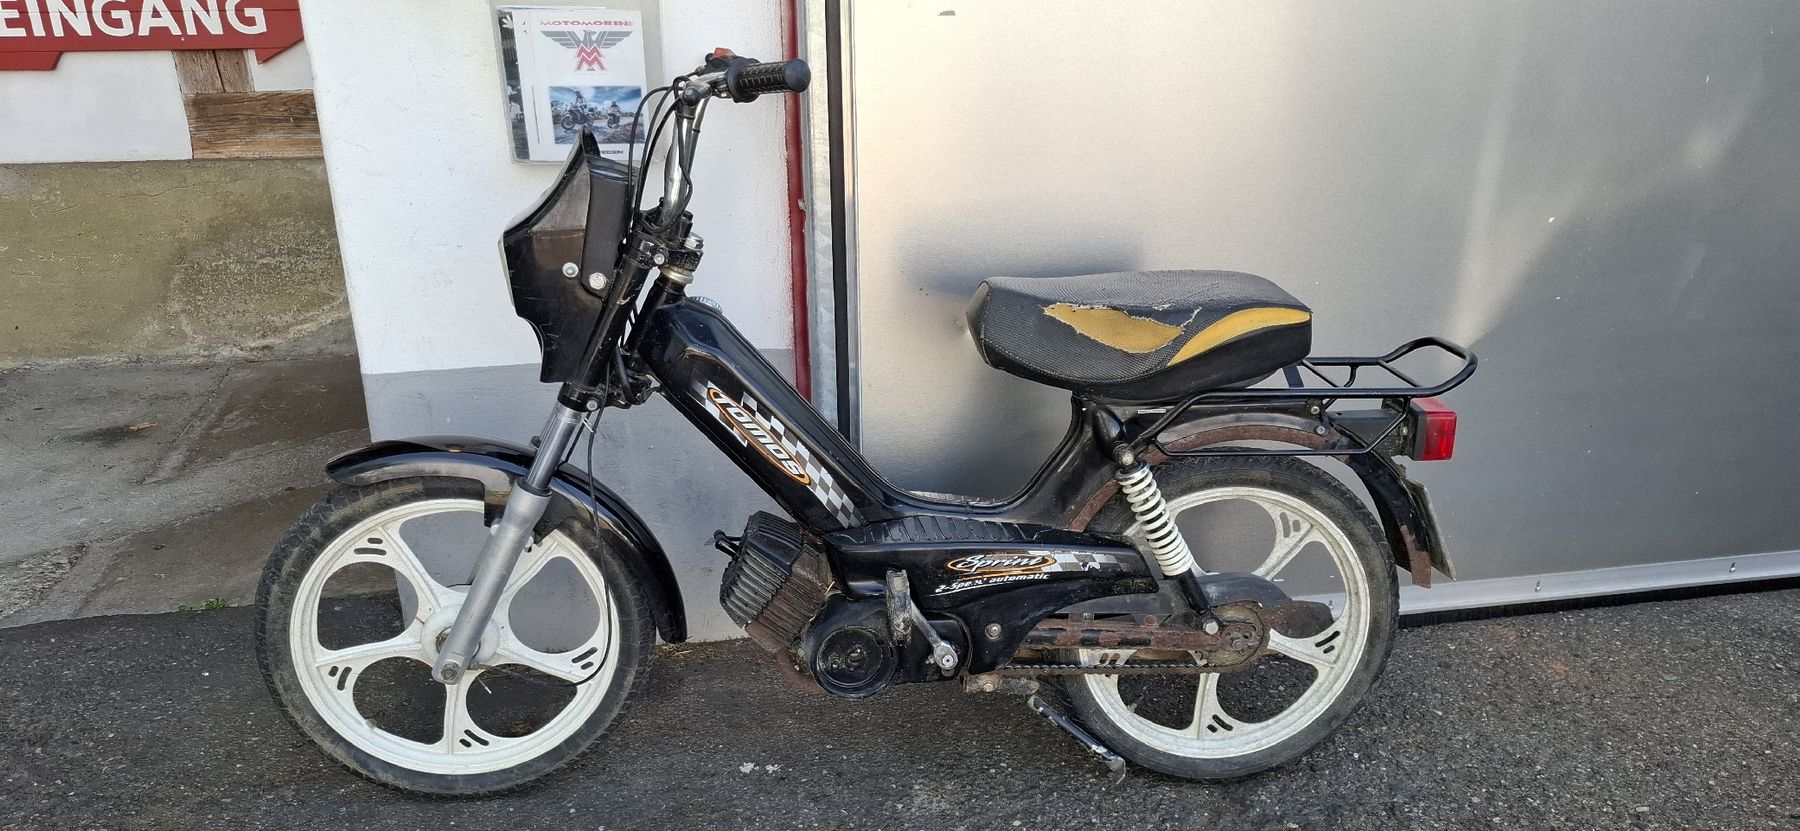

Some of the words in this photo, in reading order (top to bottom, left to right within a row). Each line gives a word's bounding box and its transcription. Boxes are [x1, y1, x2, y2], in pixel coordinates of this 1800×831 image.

[0, 0, 268, 37] EINGANG
[713, 391, 806, 476] TOMOS
[956, 554, 1045, 573] Sprint
[989, 572, 1051, 584] automatic
